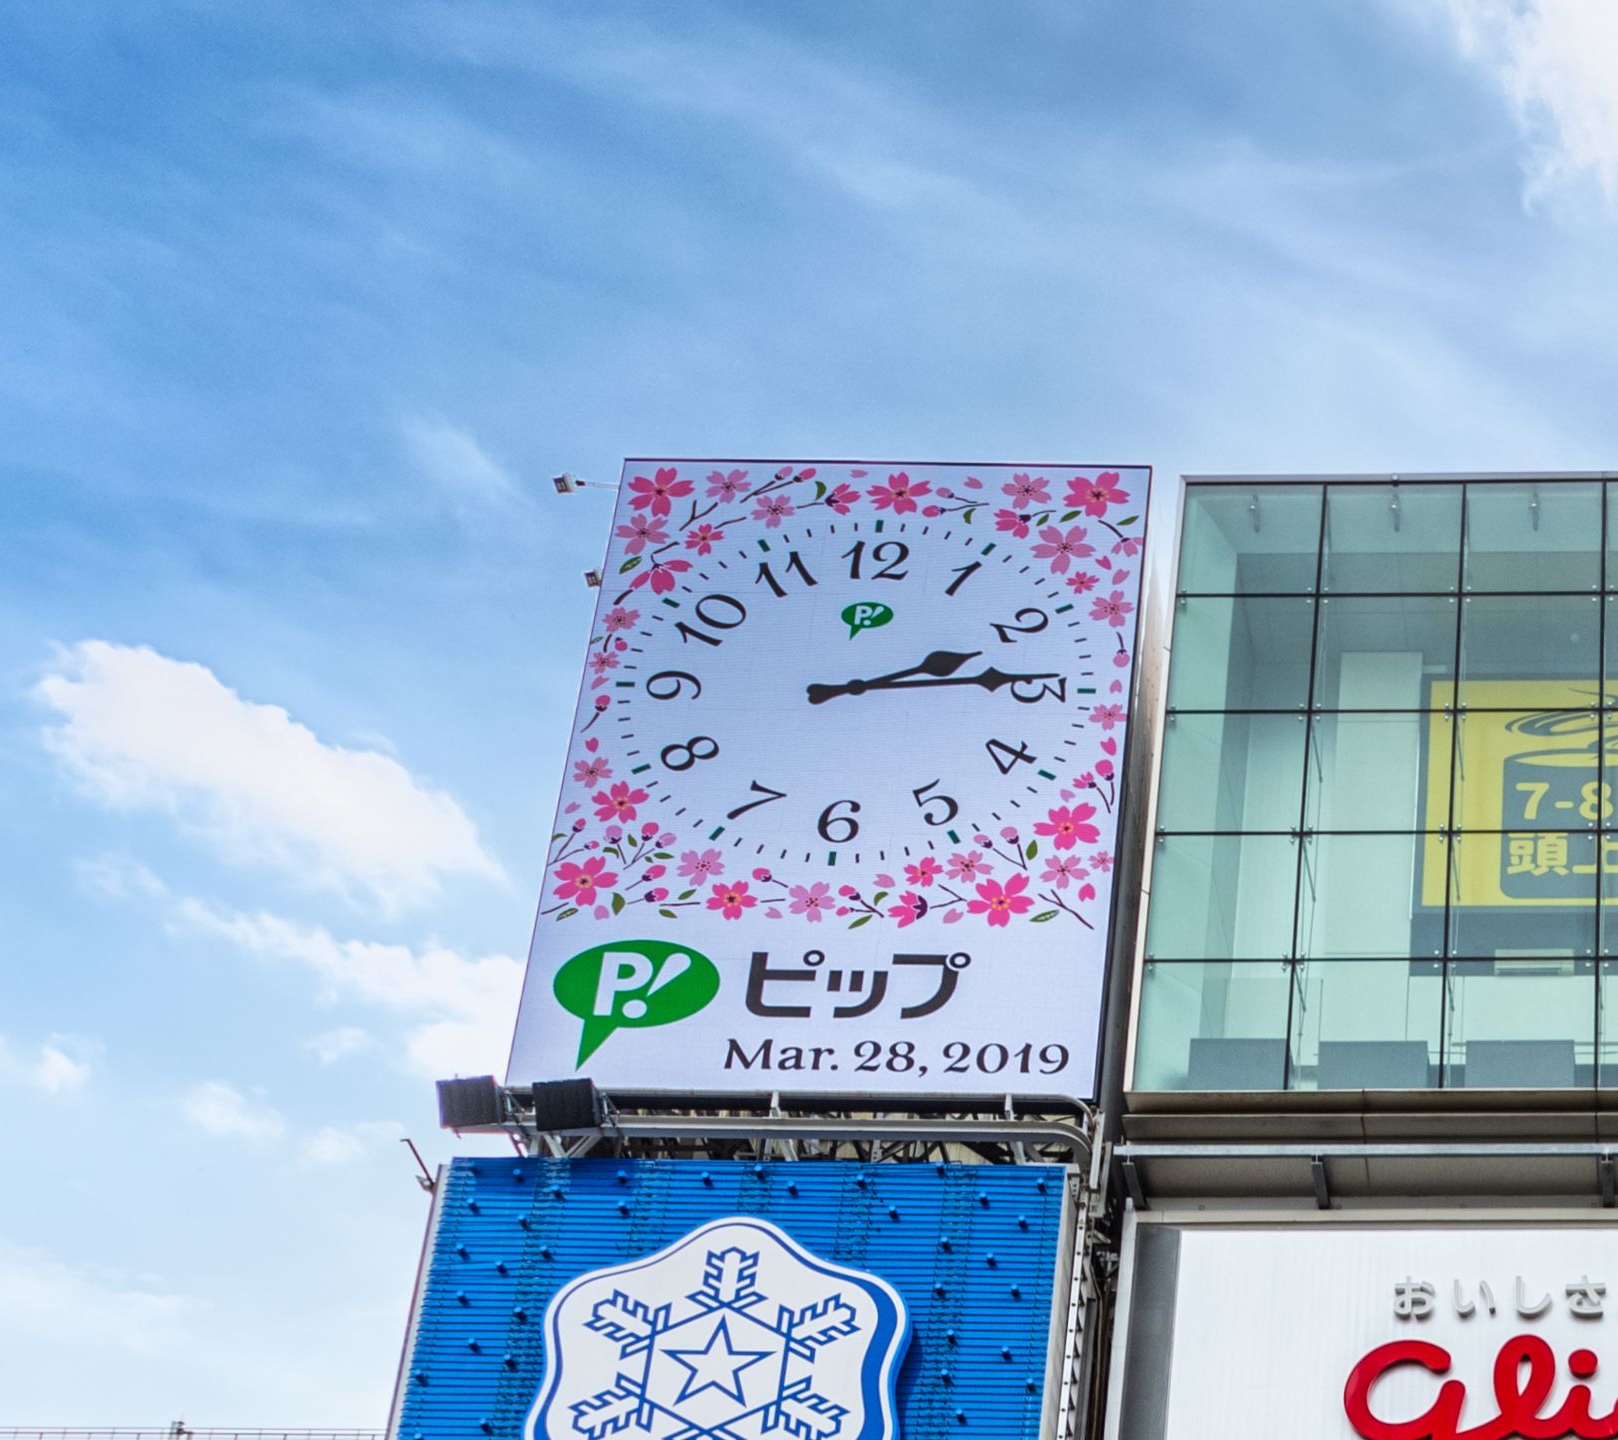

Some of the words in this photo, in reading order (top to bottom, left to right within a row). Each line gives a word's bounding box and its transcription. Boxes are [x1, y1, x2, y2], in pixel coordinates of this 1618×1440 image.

[754, 550, 818, 598] 11
[842, 540, 909, 582] 12
[945, 560, 982, 596] 1
[675, 594, 747, 647] 10
[990, 607, 1049, 644] 2
[646, 669, 702, 700] 9
[1010, 675, 1068, 704] 3
[660, 735, 720, 771] 8
[985, 738, 1037, 775] 4
[726, 780, 787, 821] 7
[912, 779, 959, 825] 5
[817, 800, 860, 843] 6
[745, 950, 971, 1019] ピップ
[724, 1039, 838, 1073] Mar.
[853, 1041, 929, 1077] 28,
[943, 1042, 1069, 1076] 2019
